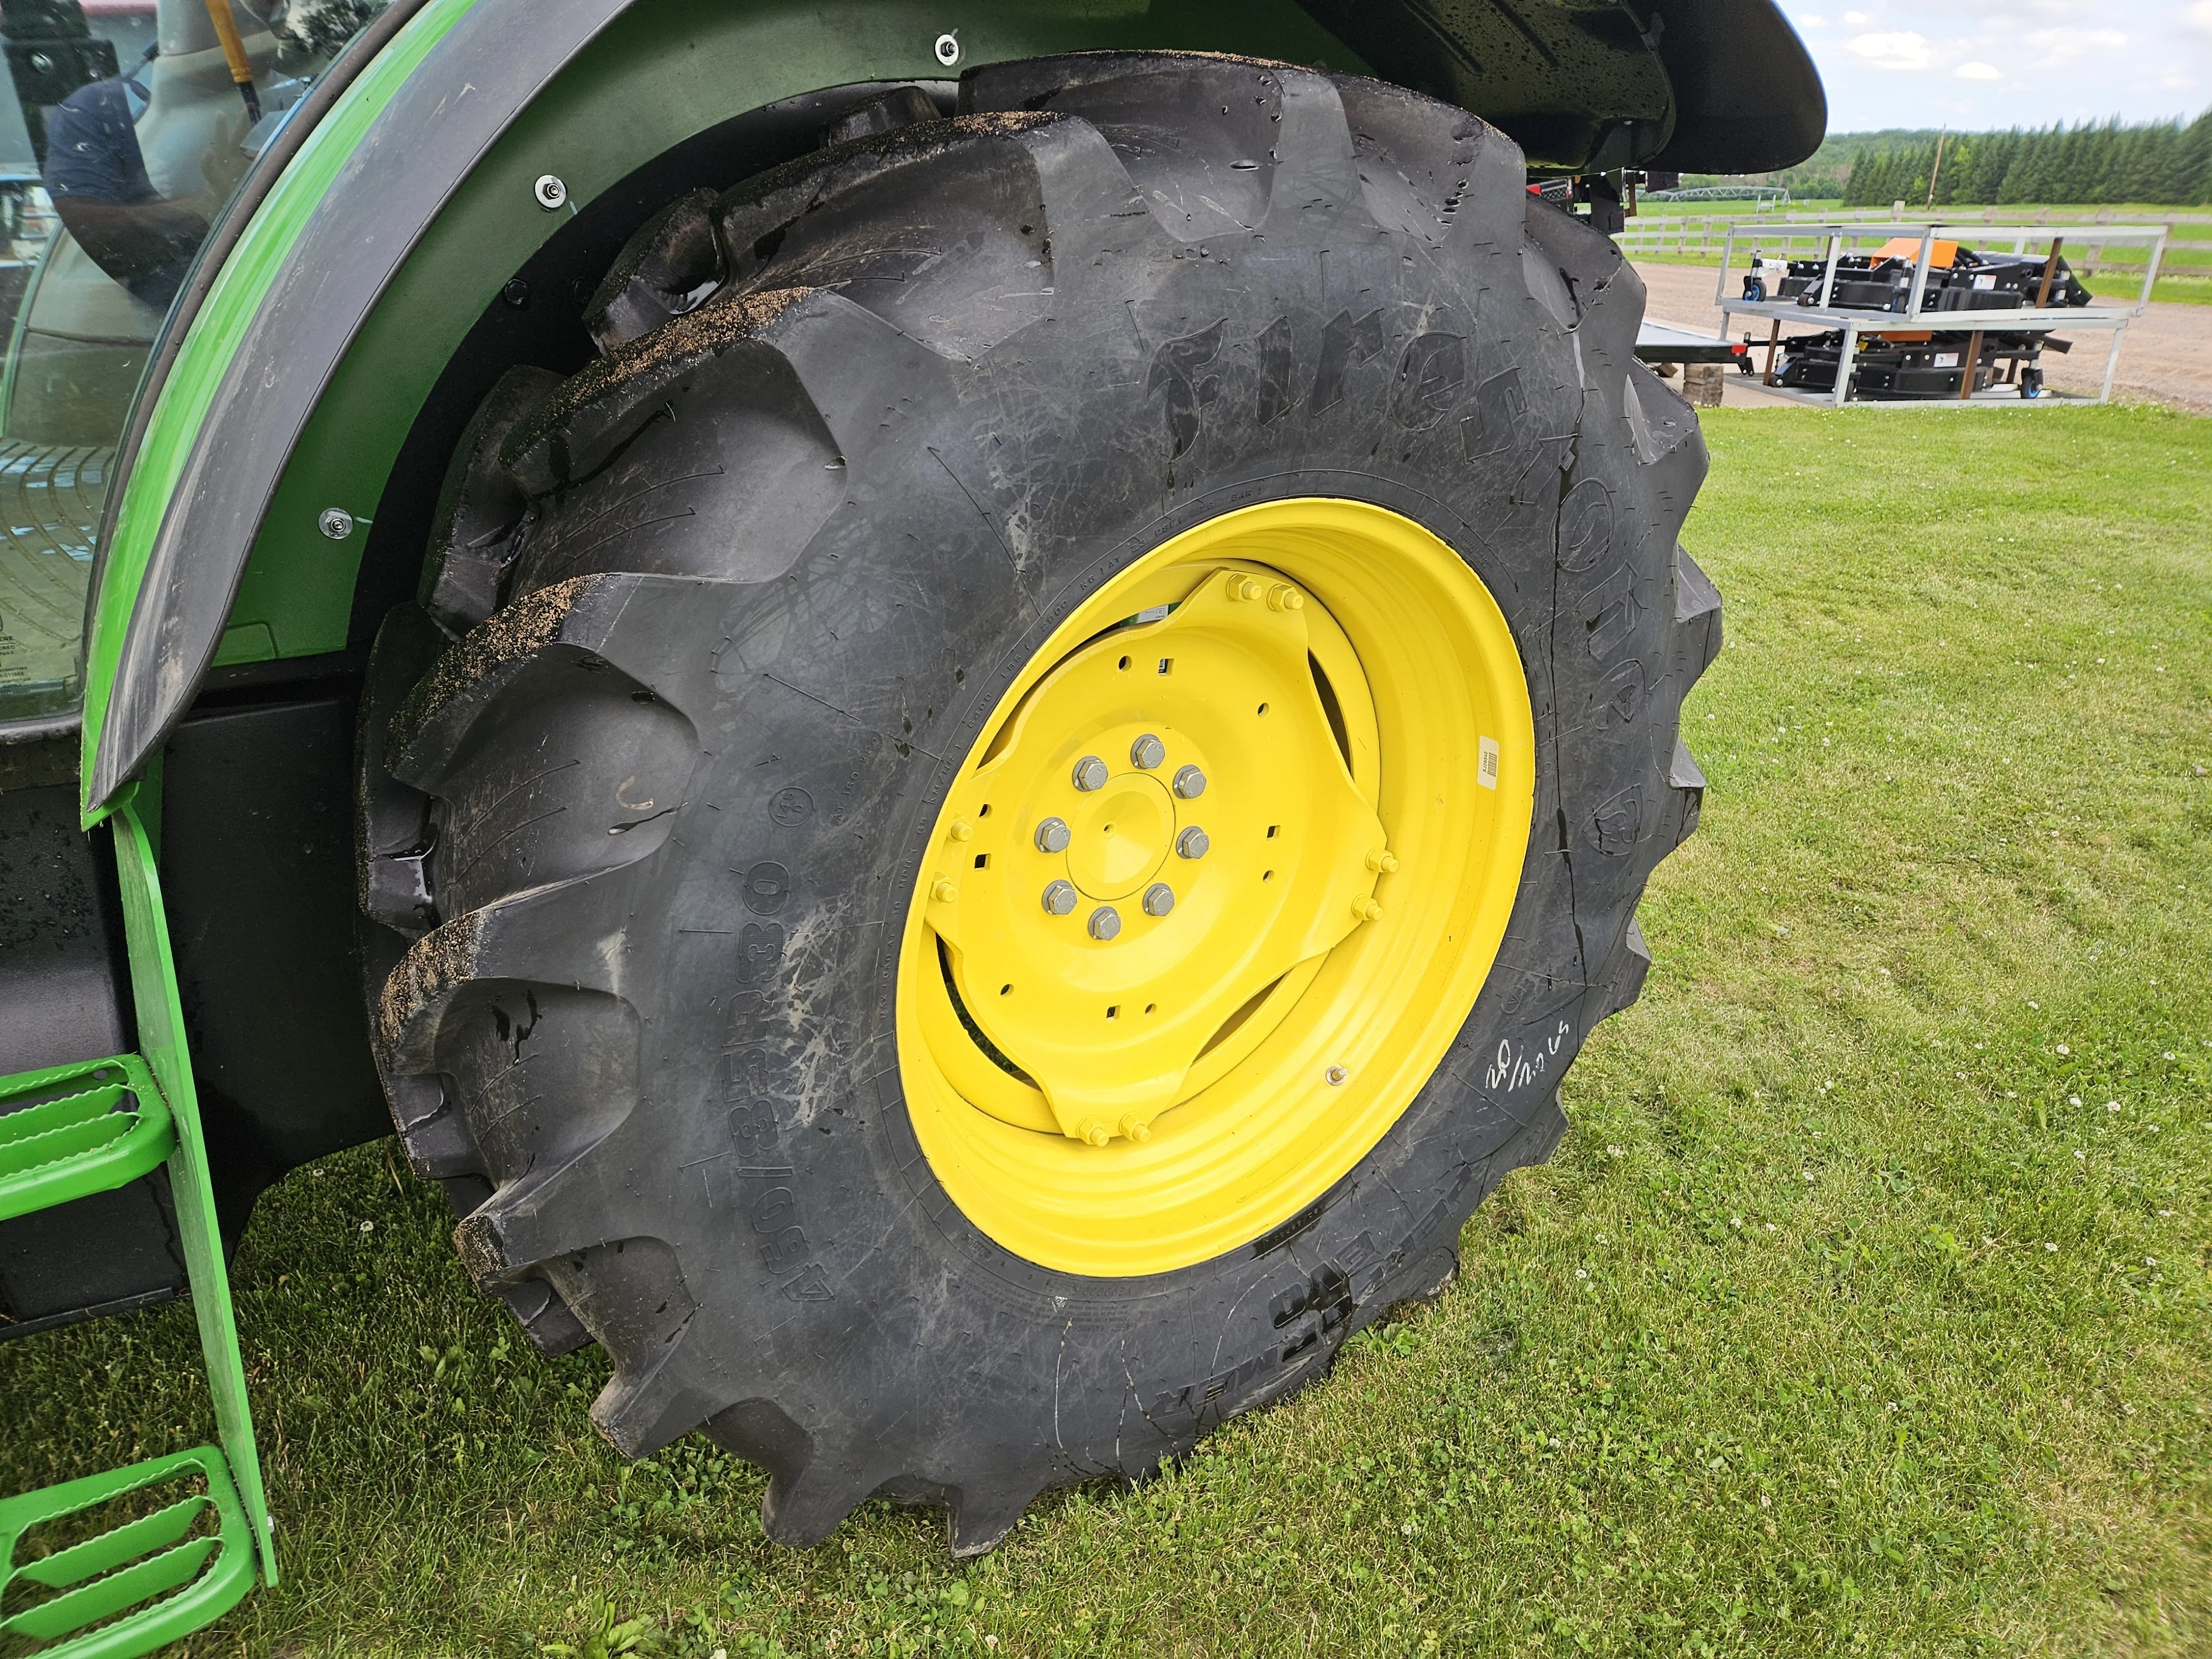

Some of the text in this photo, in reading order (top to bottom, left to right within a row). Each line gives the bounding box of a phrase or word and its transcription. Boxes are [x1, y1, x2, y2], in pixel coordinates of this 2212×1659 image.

[925, 754, 957, 806] KM/HR
[965, 690, 994, 730] 6400
[999, 651, 1022, 680] LBS
[1146, 307, 1648, 731] Firestone
[722, 860, 834, 1302] 460/85R30
